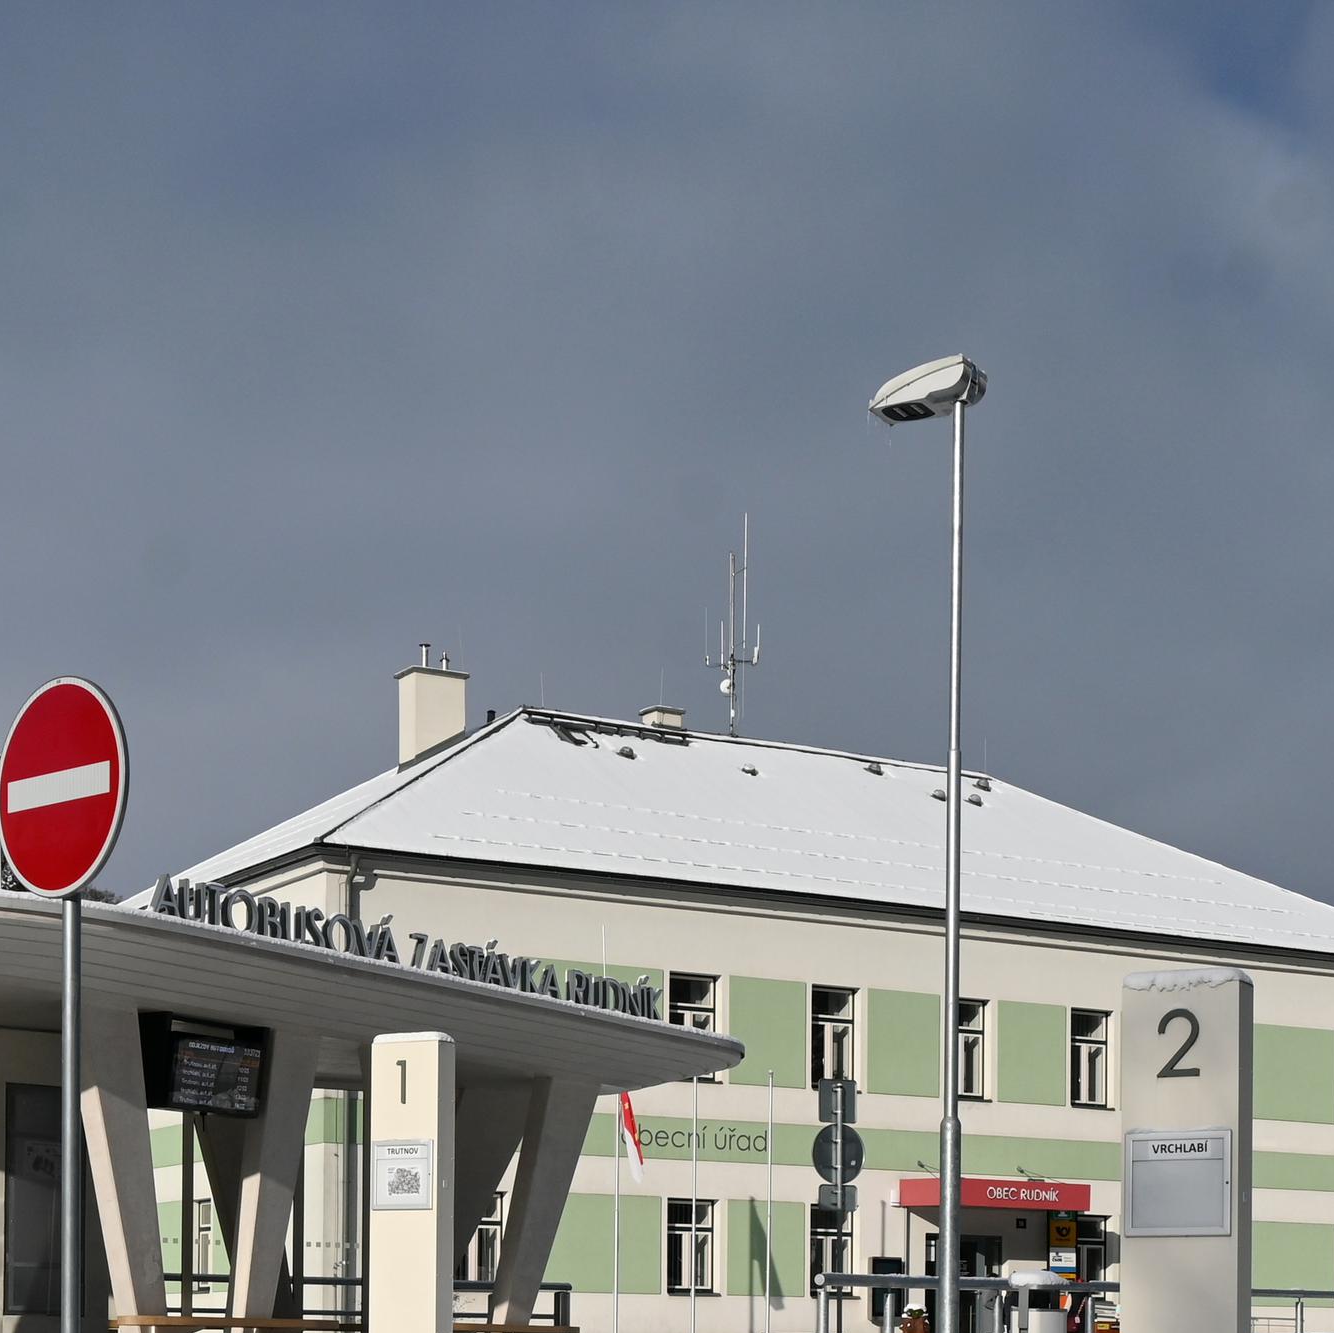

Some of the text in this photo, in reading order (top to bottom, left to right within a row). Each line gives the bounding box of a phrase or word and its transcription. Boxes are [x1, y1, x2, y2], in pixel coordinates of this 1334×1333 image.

[149, 873, 401, 964] AUTOBUSOVÁ
[565, 969, 664, 1020] RUDNÍK
[1156, 1008, 1200, 1078] 2
[396, 1060, 407, 1104] 1
[714, 1126, 768, 1152] úřad
[1152, 1140, 1209, 1154] VRCHLABÍ
[986, 1186, 1059, 1202] OBEC RUDNÍK
